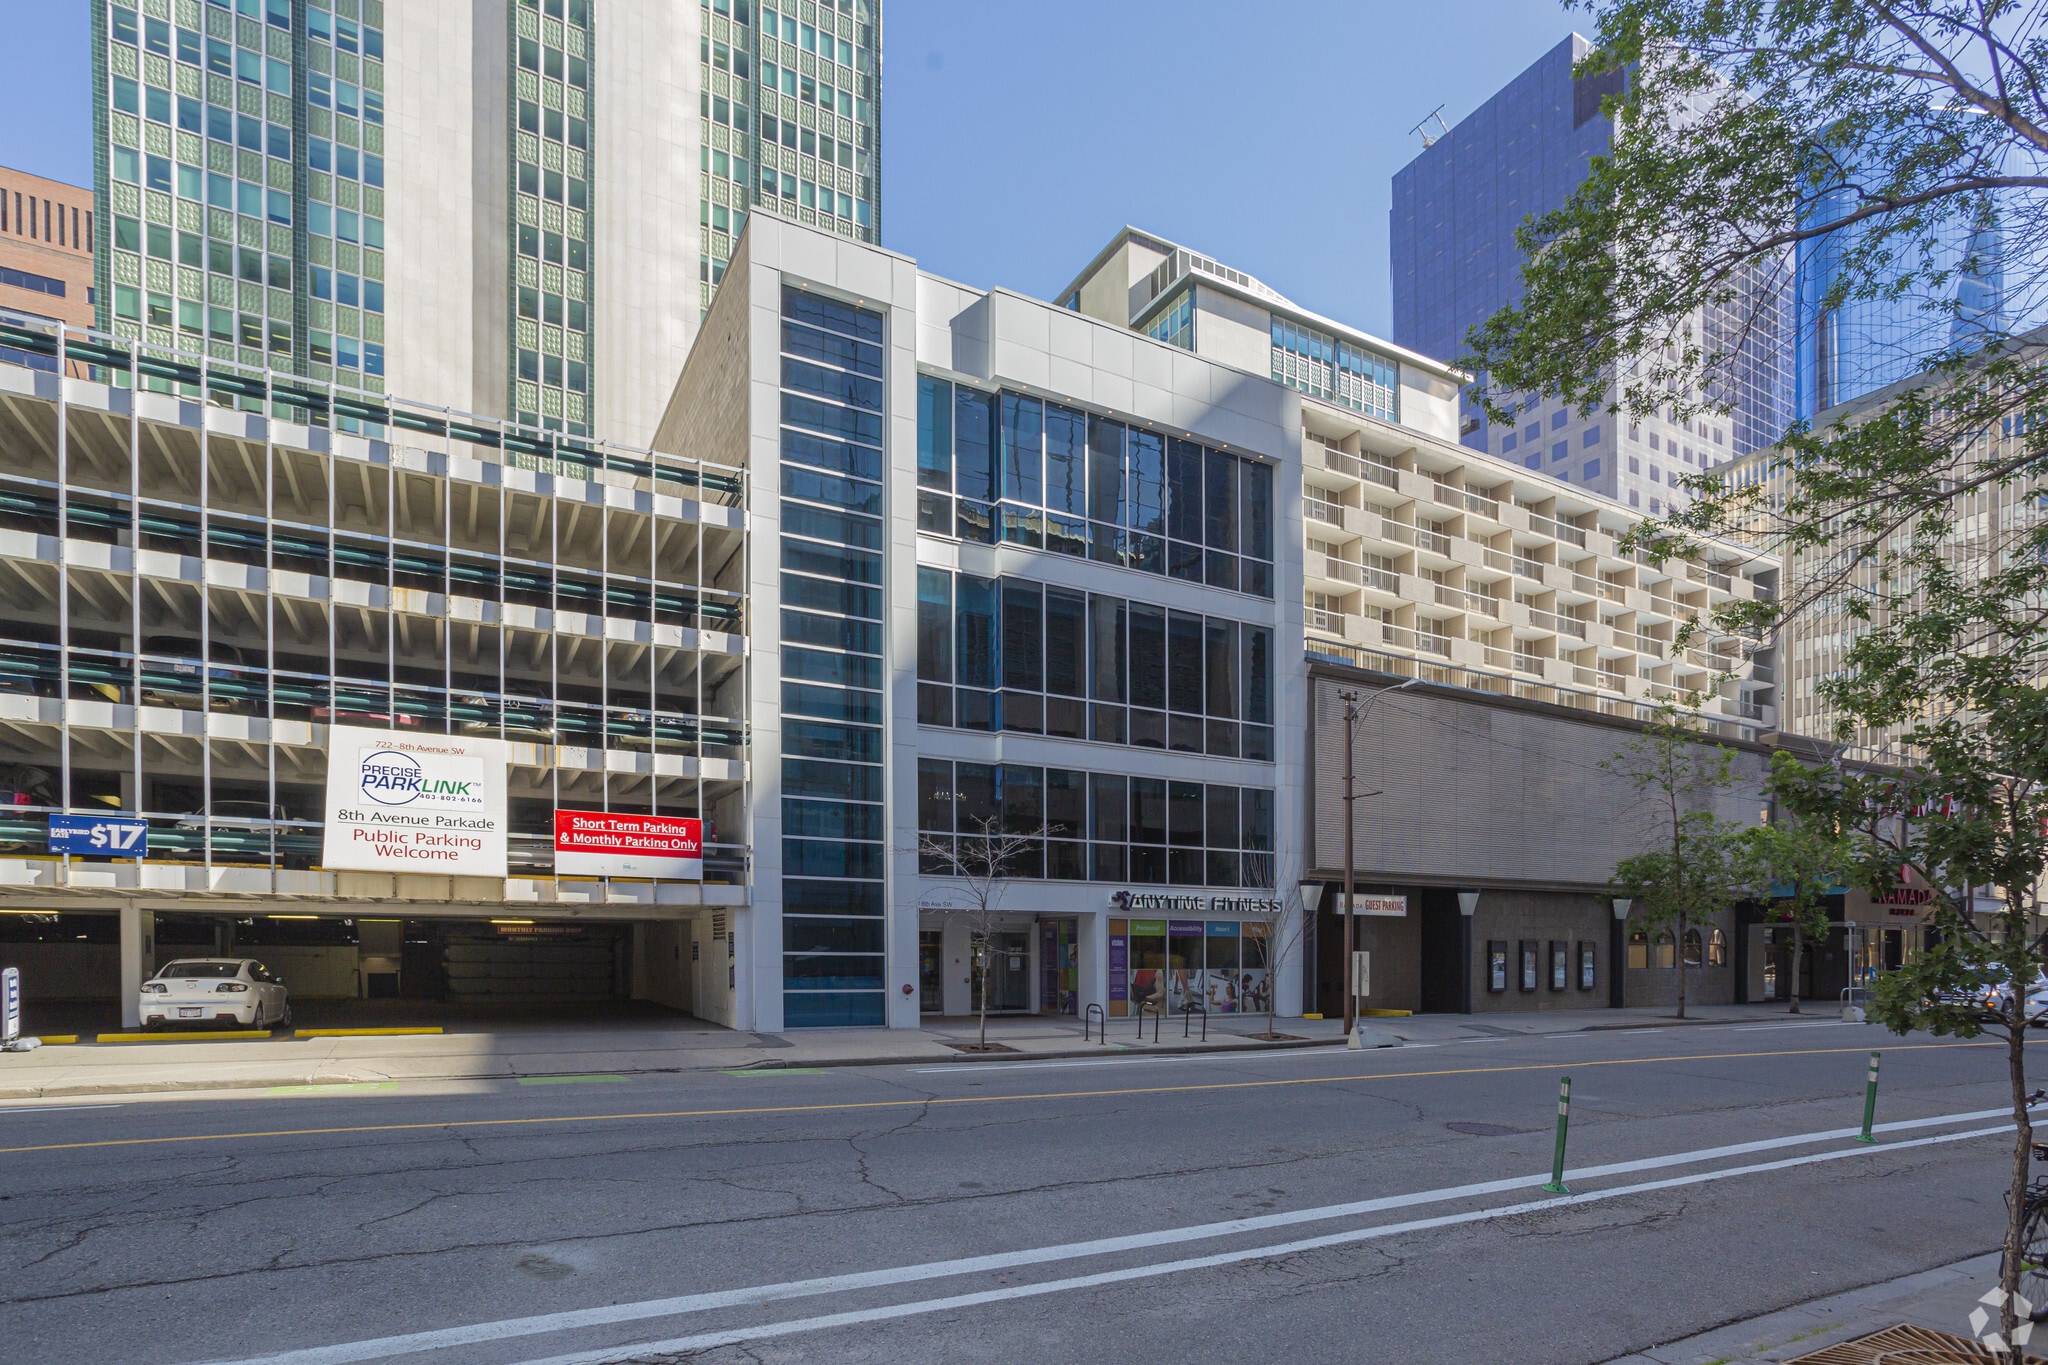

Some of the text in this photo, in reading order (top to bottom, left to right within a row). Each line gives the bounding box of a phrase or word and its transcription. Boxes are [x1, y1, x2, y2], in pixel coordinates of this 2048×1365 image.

[416, 745, 449, 754] Avenue
[361, 764, 422, 778] PRECISE
[419, 793, 482, 803] 403-802-6166
[338, 809, 495, 829] 8th Avenue Parkade
[572, 817, 686, 835] Short Term Parking
[89, 823, 146, 849] $17
[353, 828, 481, 850] Public Parking
[560, 832, 697, 851] & Monthly Parking Only
[374, 844, 459, 860] Welcome
[1130, 893, 1282, 913] ANYTIME FITNESS
[1340, 899, 1404, 911] RADA GUEST PARKING
